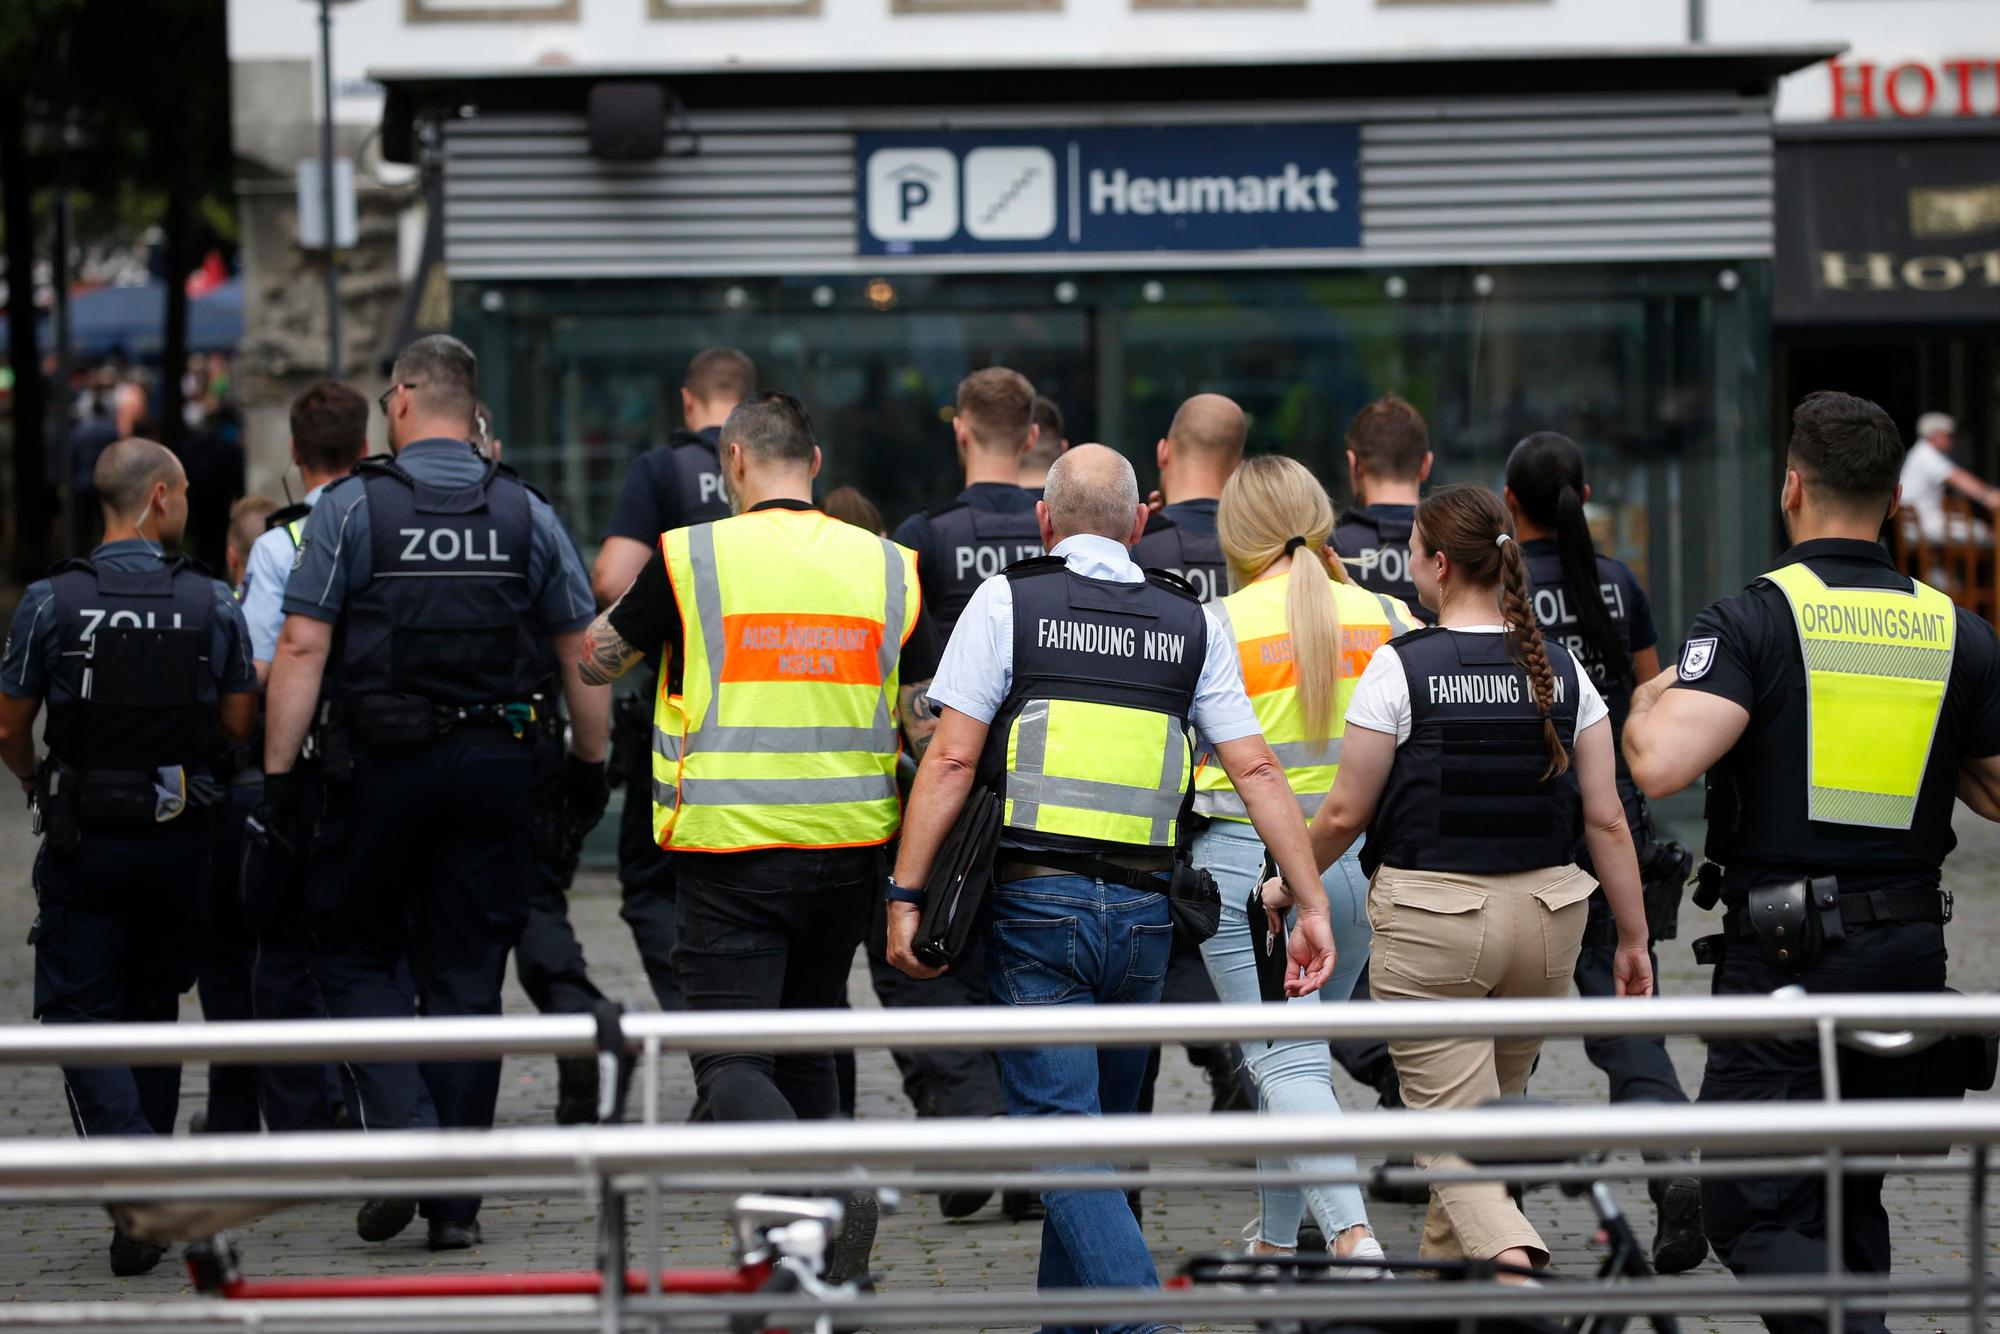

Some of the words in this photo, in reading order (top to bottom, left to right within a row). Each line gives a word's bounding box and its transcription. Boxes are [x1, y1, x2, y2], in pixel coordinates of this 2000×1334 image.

[1827, 57, 2000, 119] HOT
[899, 181, 931, 224] P
[1089, 163, 1338, 214] Heumarkt
[400, 527, 510, 561] ZOLL
[742, 620, 869, 651] AUSLÄNDERAMT
[1038, 618, 1135, 658] FAHNDUNG
[1143, 630, 1185, 664] NRW
[1802, 603, 1945, 642] ORDNUNGSAMT
[1428, 674, 1520, 704] FAHNDUNG
